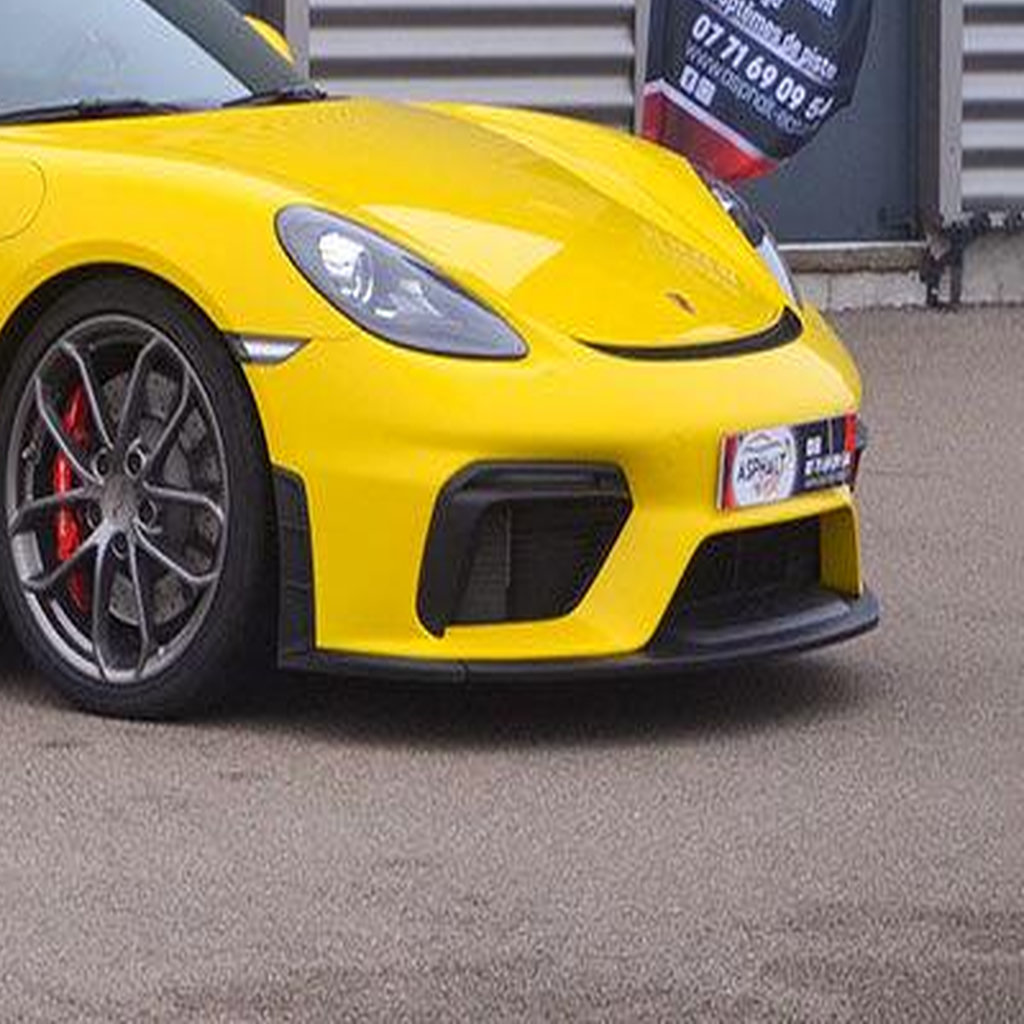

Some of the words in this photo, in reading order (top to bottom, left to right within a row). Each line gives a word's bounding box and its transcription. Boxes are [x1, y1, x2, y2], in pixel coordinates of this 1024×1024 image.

[692, 14, 724, 47] 07
[720, 35, 750, 67] 71
[746, 57, 777, 88] 69
[776, 77, 806, 110] 09
[782, 33, 802, 58] de
